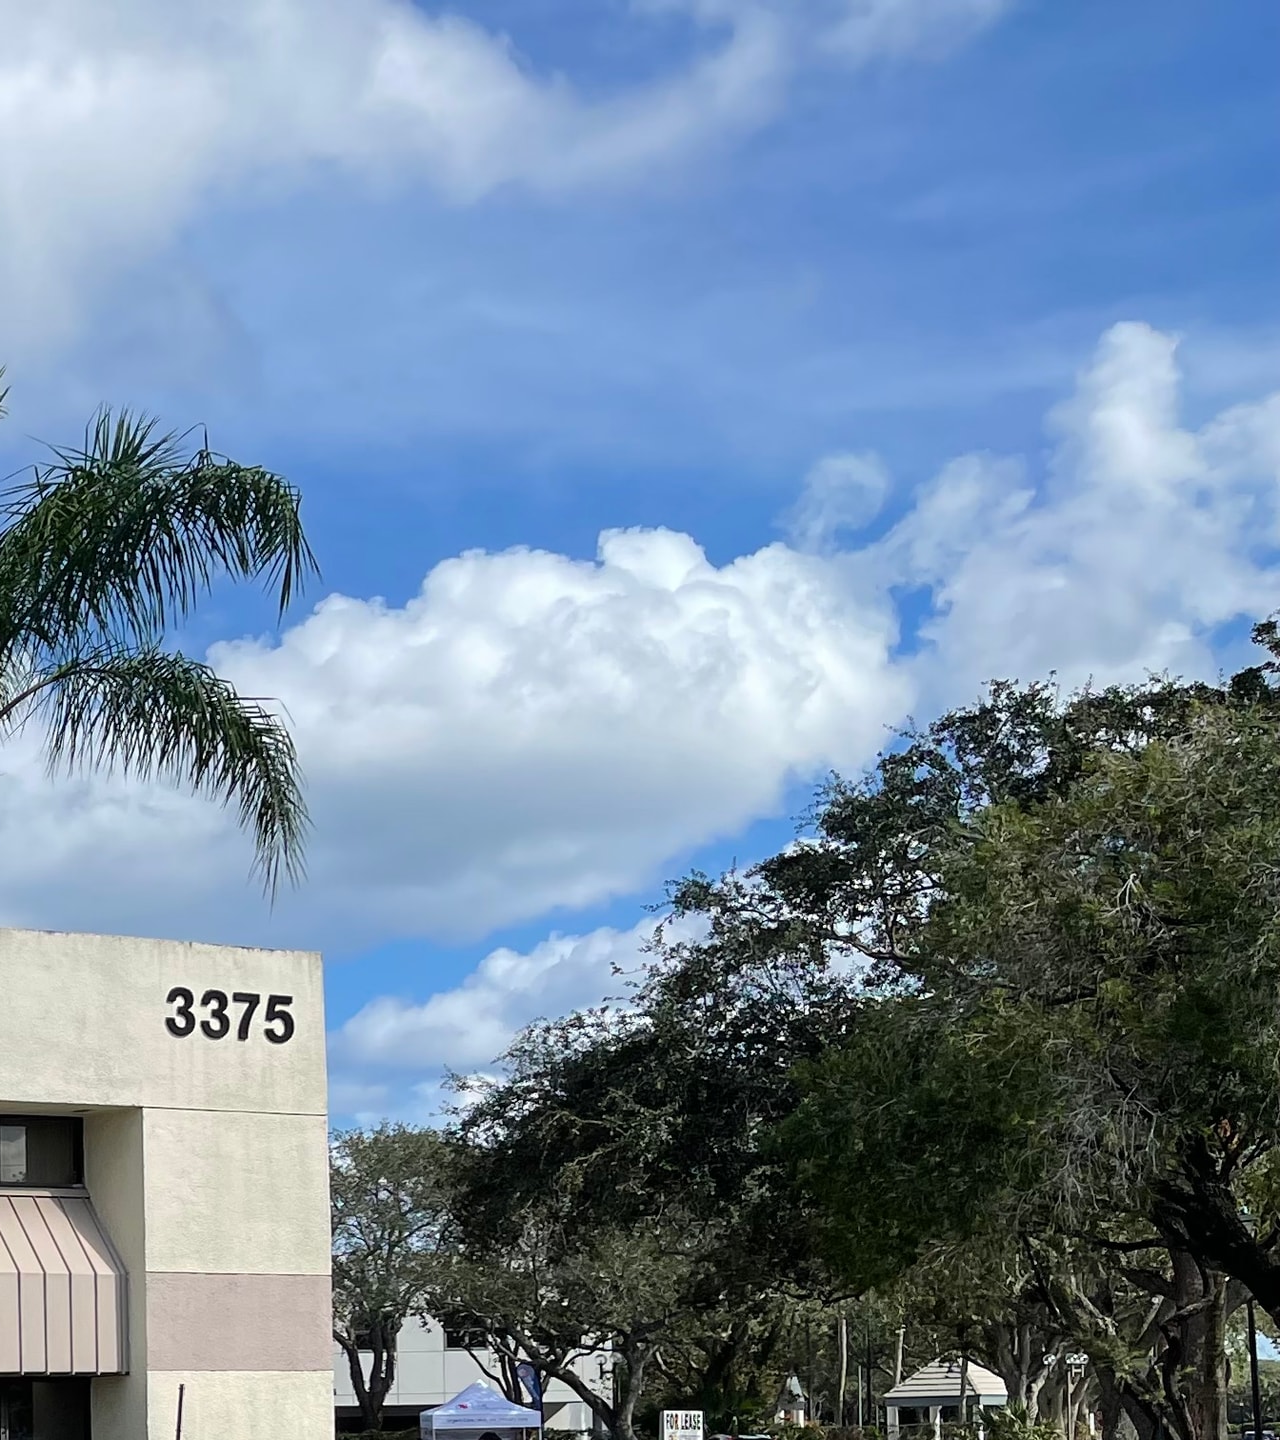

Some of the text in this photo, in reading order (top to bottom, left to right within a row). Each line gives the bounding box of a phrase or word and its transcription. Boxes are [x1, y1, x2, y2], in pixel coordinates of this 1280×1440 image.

[165, 986, 295, 1044] 3375
[666, 1413, 700, 1430] FOR LEASE
